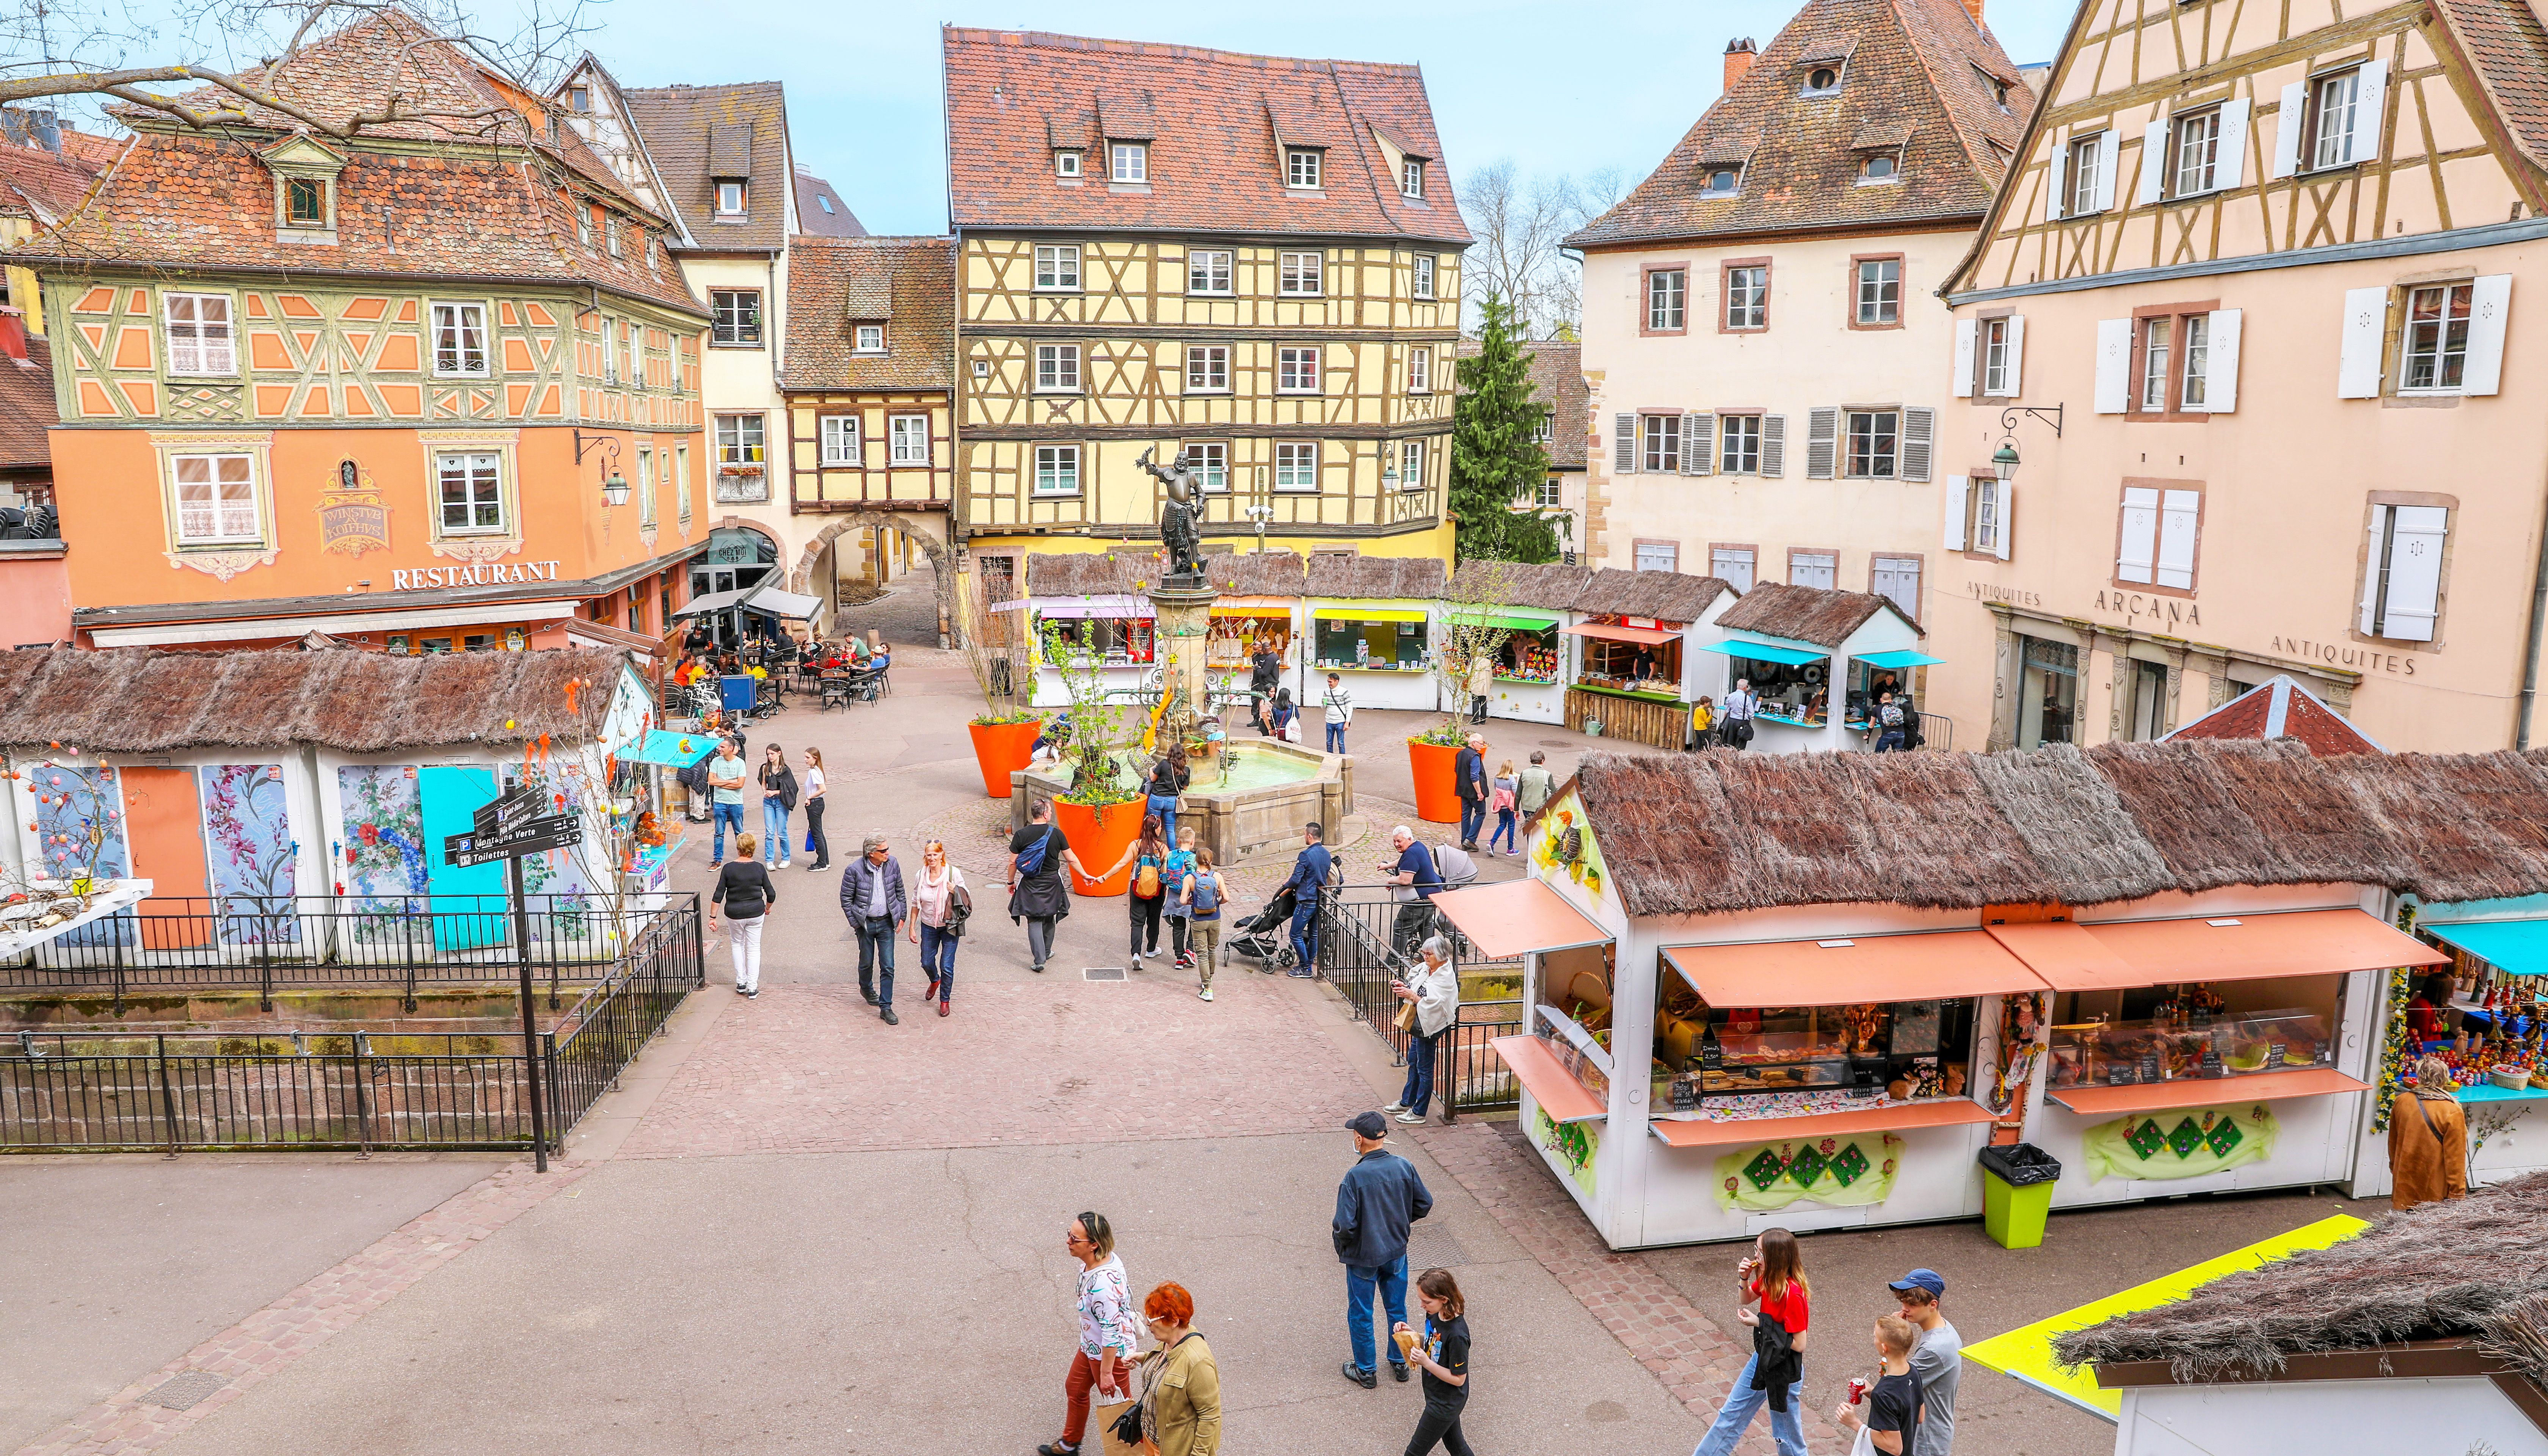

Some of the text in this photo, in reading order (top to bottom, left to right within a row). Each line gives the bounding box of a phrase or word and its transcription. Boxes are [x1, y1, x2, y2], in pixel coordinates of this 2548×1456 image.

[325, 507, 381, 521] WINSTVB
[326, 523, 382, 539] KOIFHVS
[392, 560, 560, 590] RESTAURANT
[1966, 581, 2040, 606] ANTIQUITES
[2095, 590, 2199, 624] ARCANA
[2270, 636, 2414, 675] ANTIQUITES
[504, 801, 524, 816] Saint-Josse
[508, 813, 531, 831] Média-Culture
[475, 834, 513, 847] Montagne
[515, 828, 536, 838] Verte
[473, 849, 509, 862] Toilettes
